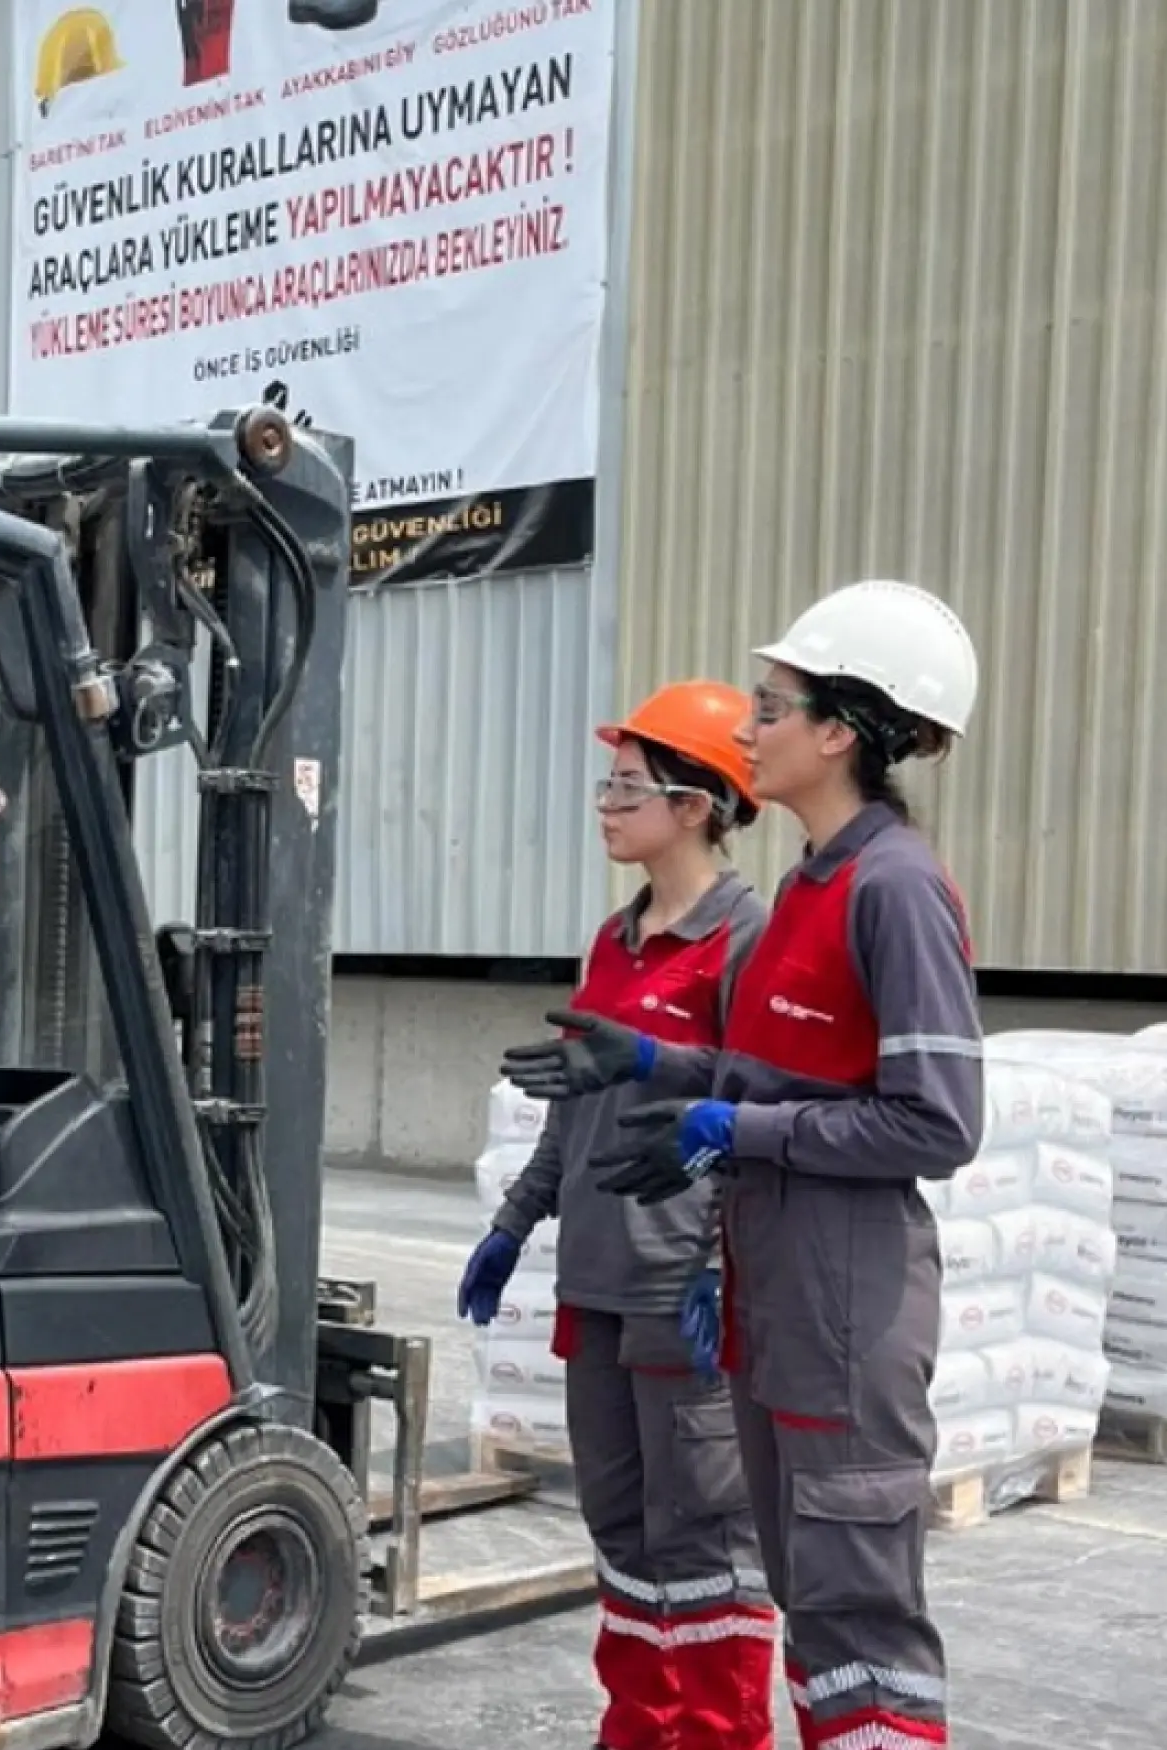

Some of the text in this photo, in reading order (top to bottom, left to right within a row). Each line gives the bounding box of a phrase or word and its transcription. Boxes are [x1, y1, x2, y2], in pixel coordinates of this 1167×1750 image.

[280, 52, 383, 98] AYAKKABINI
[233, 87, 265, 112] TAK
[33, 52, 573, 236] GÜVENLİK KURALLARINA UYMAYAN
[97, 129, 126, 152] TAK
[29, 233, 154, 299] ARAÇLARA
[159, 202, 280, 269] YÜKLEME
[286, 133, 555, 239] YAPILMAYACAKTIR
[30, 306, 111, 360] YÜKLEME
[113, 281, 177, 343] SÜRESİ
[179, 272, 266, 330] BOYUNCA
[271, 236, 429, 309] ARAÇLARINIZDA
[193, 353, 240, 382] ÖNCE
[264, 325, 361, 369] GÜVENLİĞİ
[365, 468, 453, 500] ATMAYIN
[352, 501, 503, 545] GÜVENLİĞİ
